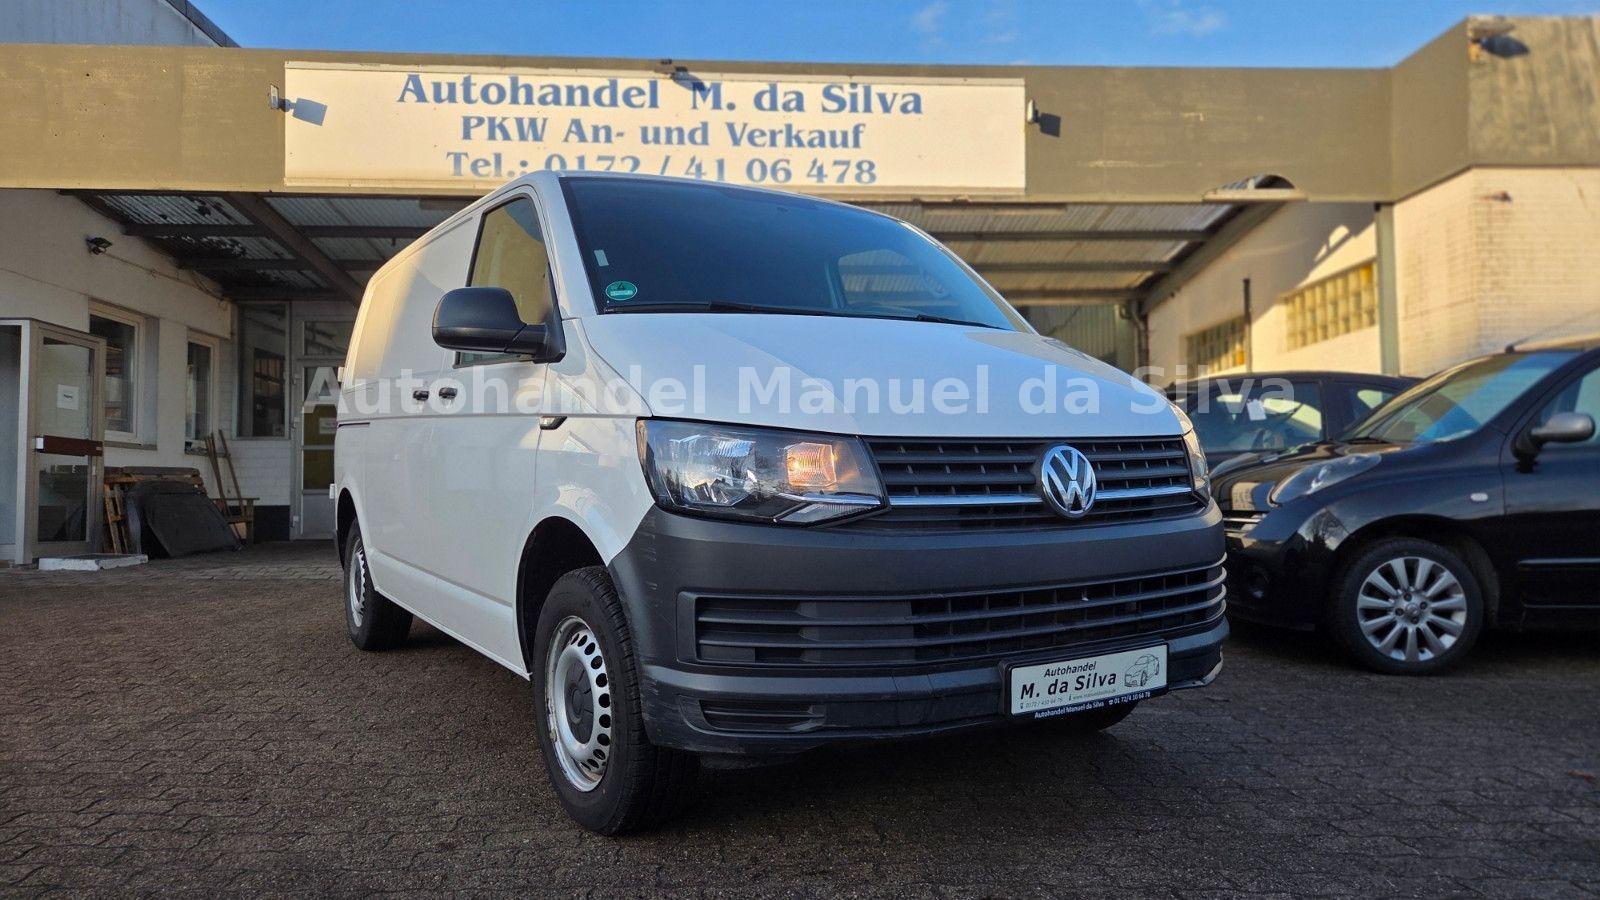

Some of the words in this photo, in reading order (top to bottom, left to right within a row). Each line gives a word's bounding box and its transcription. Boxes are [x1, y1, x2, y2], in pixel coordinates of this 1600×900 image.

[397, 73, 659, 109] Autohandel
[691, 80, 736, 112] M.
[753, 81, 805, 112] da
[821, 82, 922, 115] Silva
[461, 115, 549, 142] PKW
[562, 118, 625, 144] An-
[639, 121, 709, 146] und
[724, 122, 866, 149] Verkauf
[684, 155, 726, 182] 41
[745, 157, 792, 184] 06
[806, 157, 878, 185] 478
[1043, 661, 1097, 678] Autohandel
[1020, 682, 1040, 700] M.
[1047, 678, 1069, 696] da
[1074, 672, 1117, 691] Silva
[1034, 707, 1065, 720] Autohandel
[1065, 703, 1086, 715] Manuel
[1093, 700, 1105, 709] Silva
